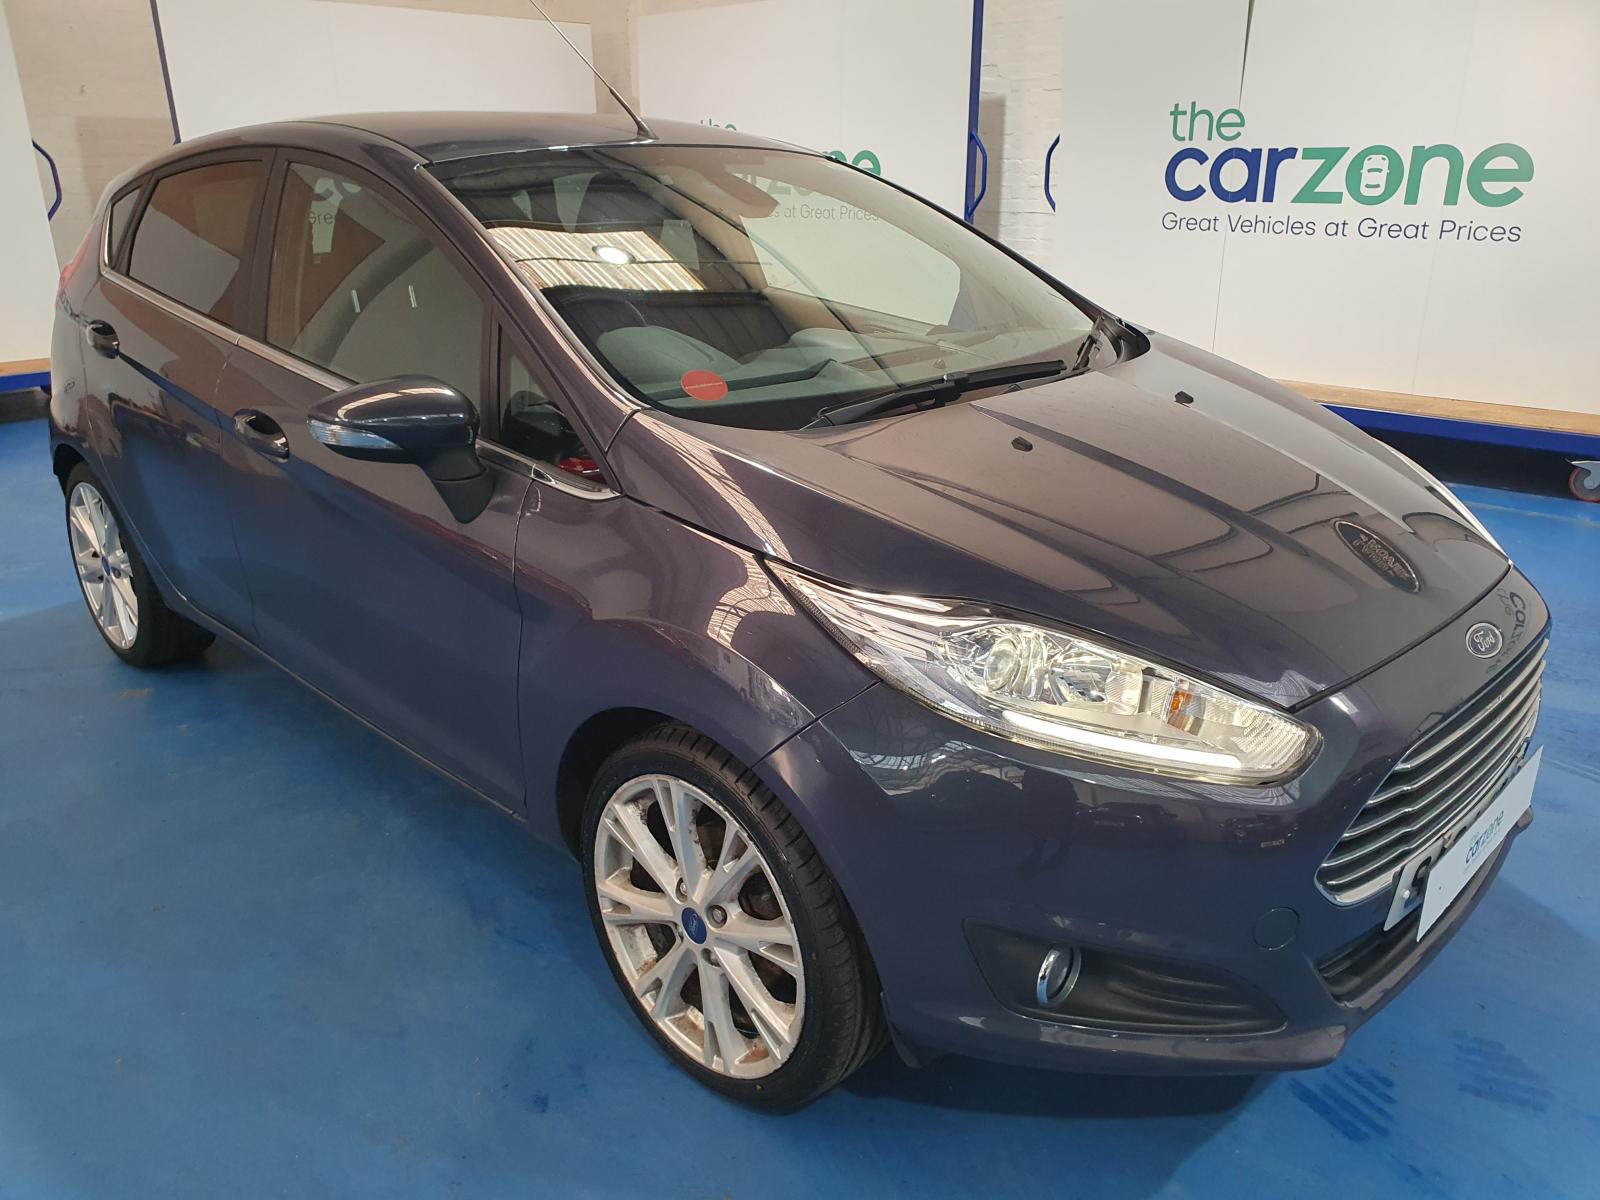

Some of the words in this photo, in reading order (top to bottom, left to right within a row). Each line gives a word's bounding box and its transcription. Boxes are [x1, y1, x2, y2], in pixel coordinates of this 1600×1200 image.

[1169, 101, 1246, 142] the
[1164, 142, 1535, 208] carzone
[800, 203, 834, 220] Great
[1161, 211, 1220, 232] Great
[1227, 214, 1316, 236] Vehicles
[1324, 219, 1349, 237] at
[1357, 217, 1430, 240] Great
[1438, 219, 1522, 242] Prices
[1473, 630, 1496, 652] Ford
